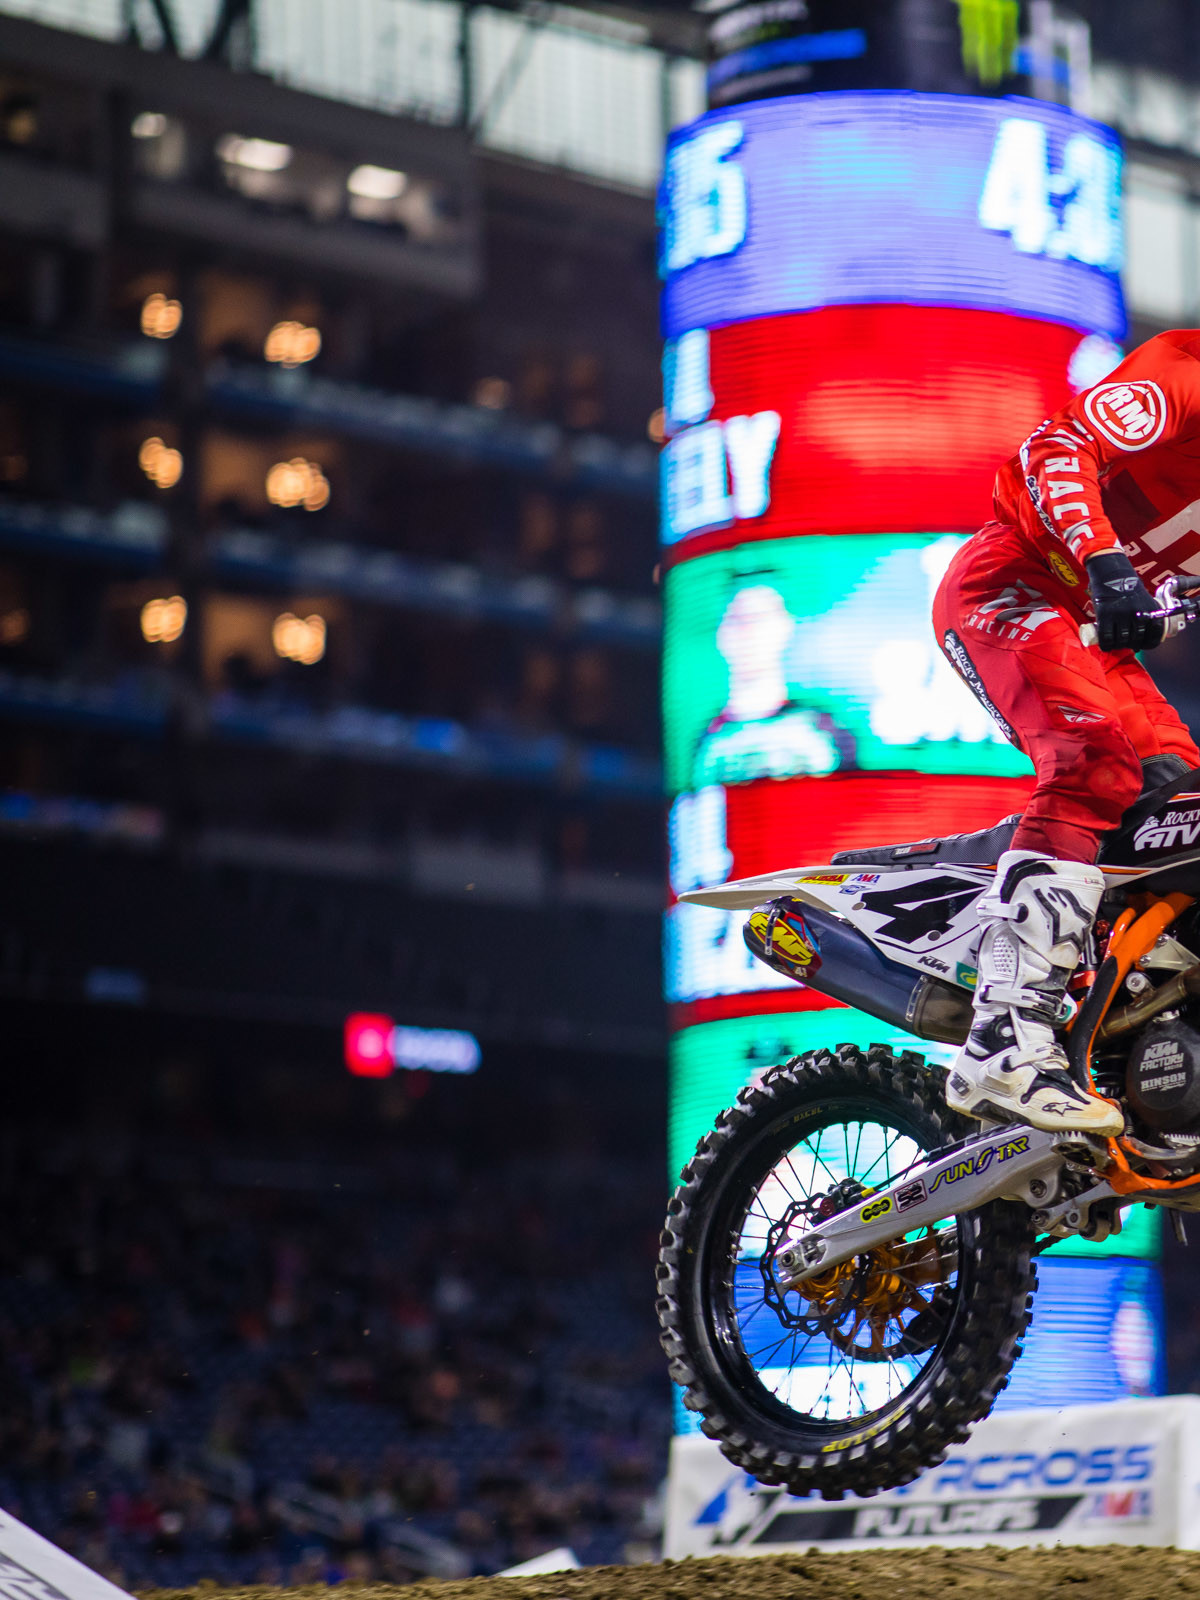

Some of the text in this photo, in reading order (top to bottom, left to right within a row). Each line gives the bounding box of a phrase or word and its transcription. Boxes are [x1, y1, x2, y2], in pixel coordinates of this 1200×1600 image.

[967, 613, 1034, 642] RACING
[955, 644, 978, 680] ROCKY
[972, 678, 1013, 736] MOUNTAIN
[851, 873, 882, 884] AMA
[860, 875, 990, 944] 4
[916, 956, 951, 974] KTM
[1143, 1040, 1178, 1061] KTM
[1139, 1052, 1184, 1072] FACTORY
[1141, 1072, 1186, 1090] HINSON
